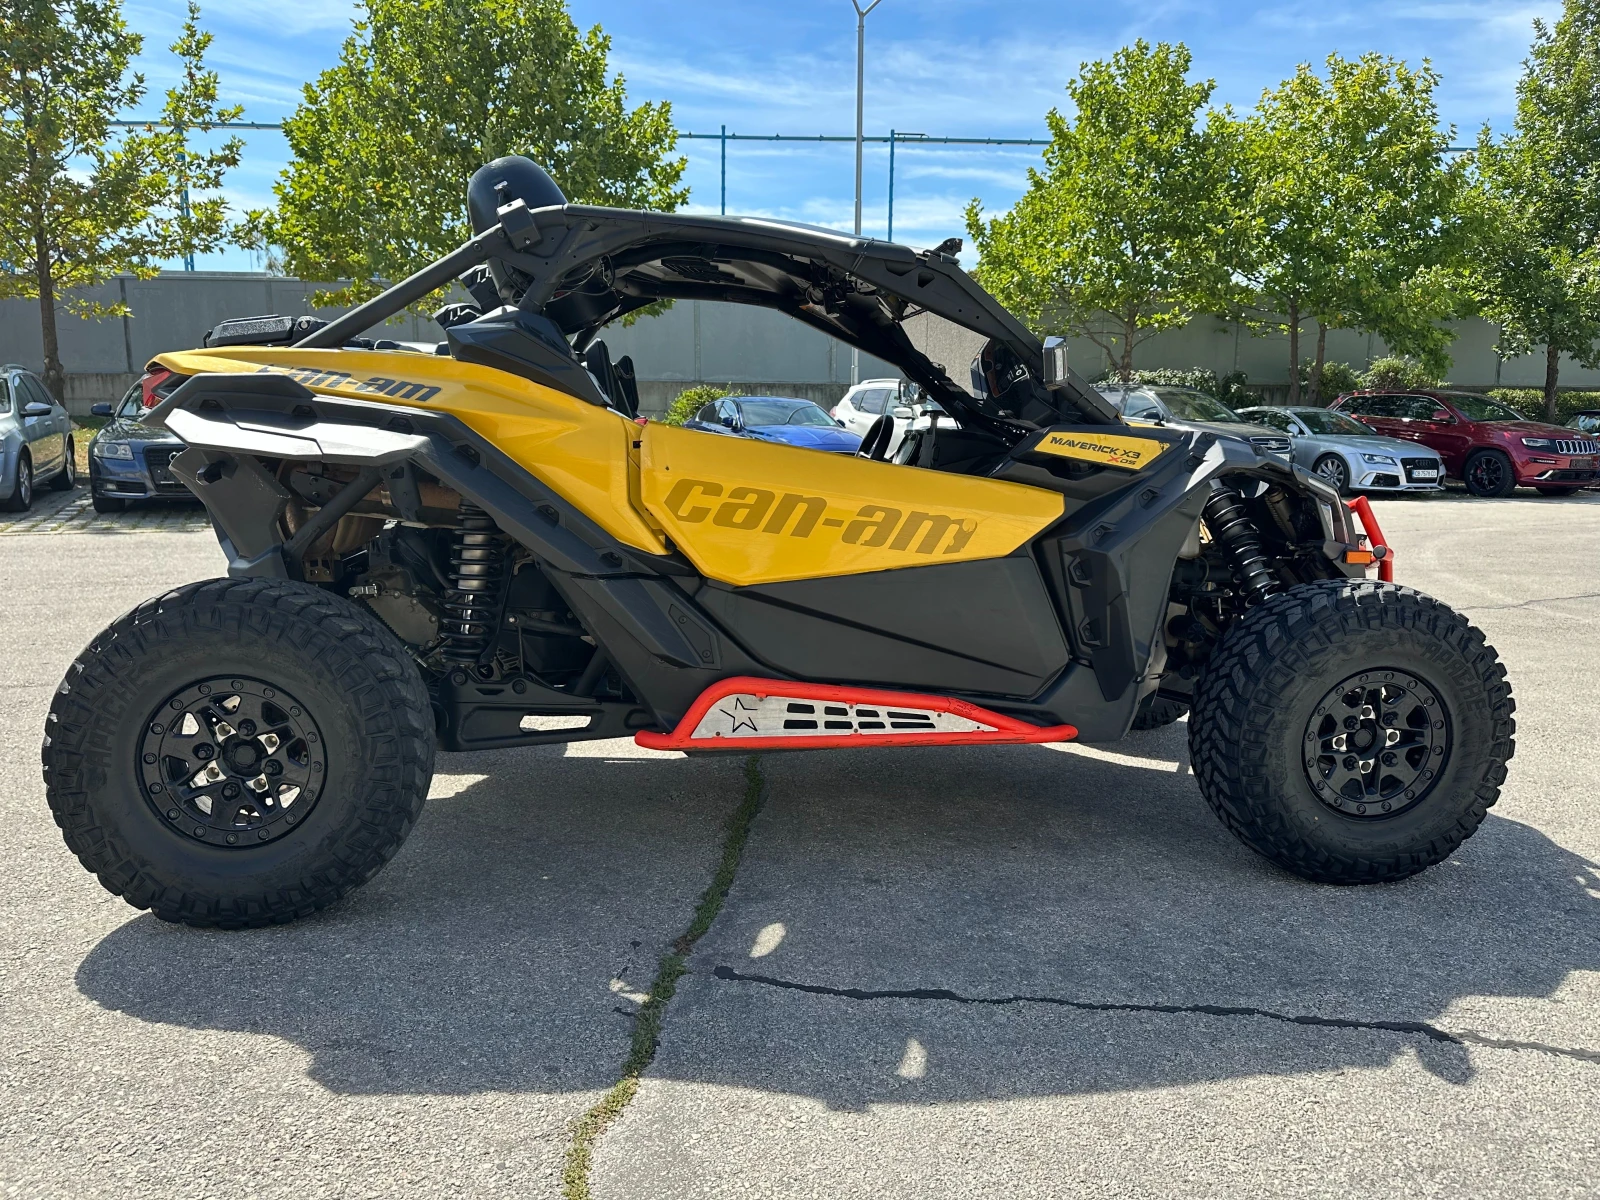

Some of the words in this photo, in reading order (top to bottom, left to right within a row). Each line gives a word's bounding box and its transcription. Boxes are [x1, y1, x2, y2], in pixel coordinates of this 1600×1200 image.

[1050, 436, 1120, 455] MAVERICK
[1121, 449, 1141, 459] X3
[1422, 640, 1485, 712] APACHE
[88, 667, 146, 768] APACHE
